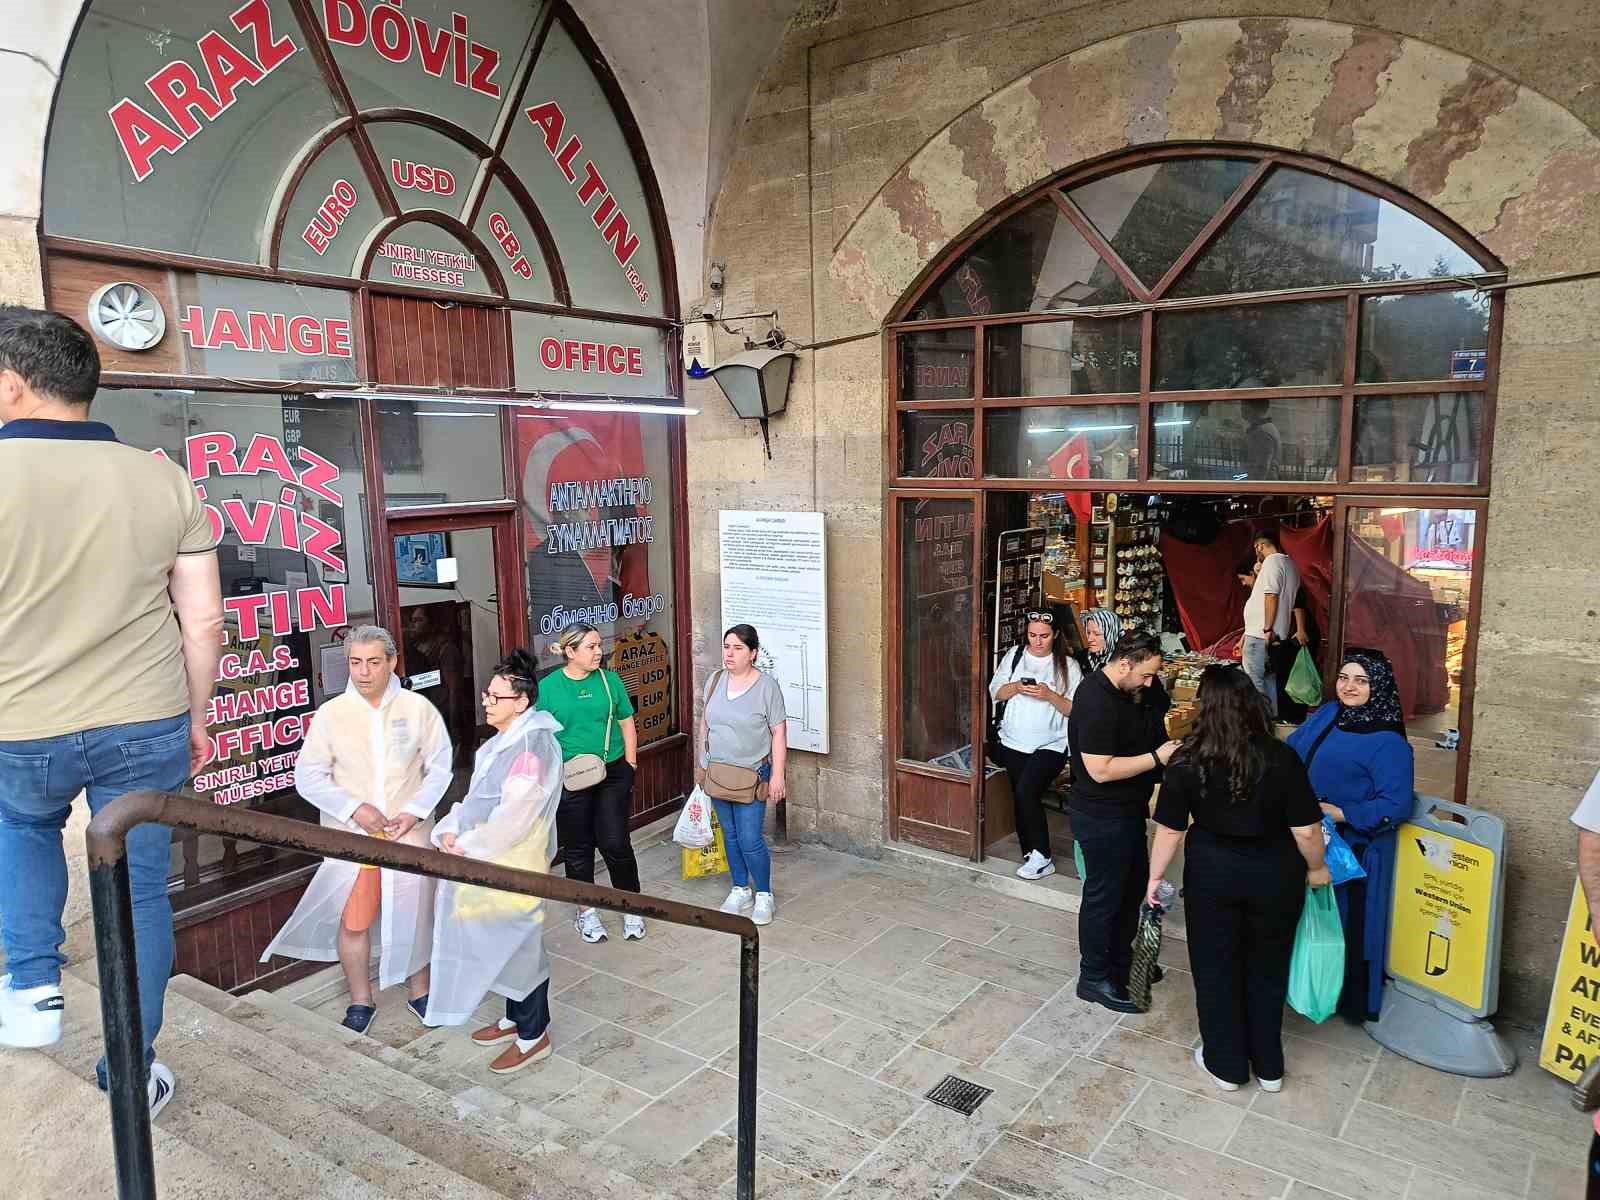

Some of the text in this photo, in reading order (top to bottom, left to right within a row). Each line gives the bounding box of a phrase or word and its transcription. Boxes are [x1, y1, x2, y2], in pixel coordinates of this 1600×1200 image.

[108, 0, 298, 182] ARAZ
[392, 159, 456, 196] USD
[525, 100, 641, 268] ALTIN
[303, 179, 357, 256] EURO
[488, 212, 533, 280] GBP
[425, 250, 477, 272] YETKİLİ
[391, 262, 465, 286] MÜESSESE
[540, 337, 643, 376] OFFICE
[1469, 359, 1477, 371] 7
[283, 409, 300, 424] EUR
[285, 429, 302, 443] GBP
[287, 447, 299, 461] CH
[151, 432, 343, 508] RAZ
[540, 593, 664, 634] обменно бюро
[621, 642, 656, 661] ARAZ
[642, 669, 664, 684] USD
[643, 691, 663, 707] EUR
[643, 712, 665, 729] GBP
[194, 761, 257, 793] SINIRLI
[214, 771, 296, 806] MÜESSES
[1415, 887, 1449, 905] Western
[1449, 900, 1472, 914] Union
[1561, 1022, 1573, 1036] &
